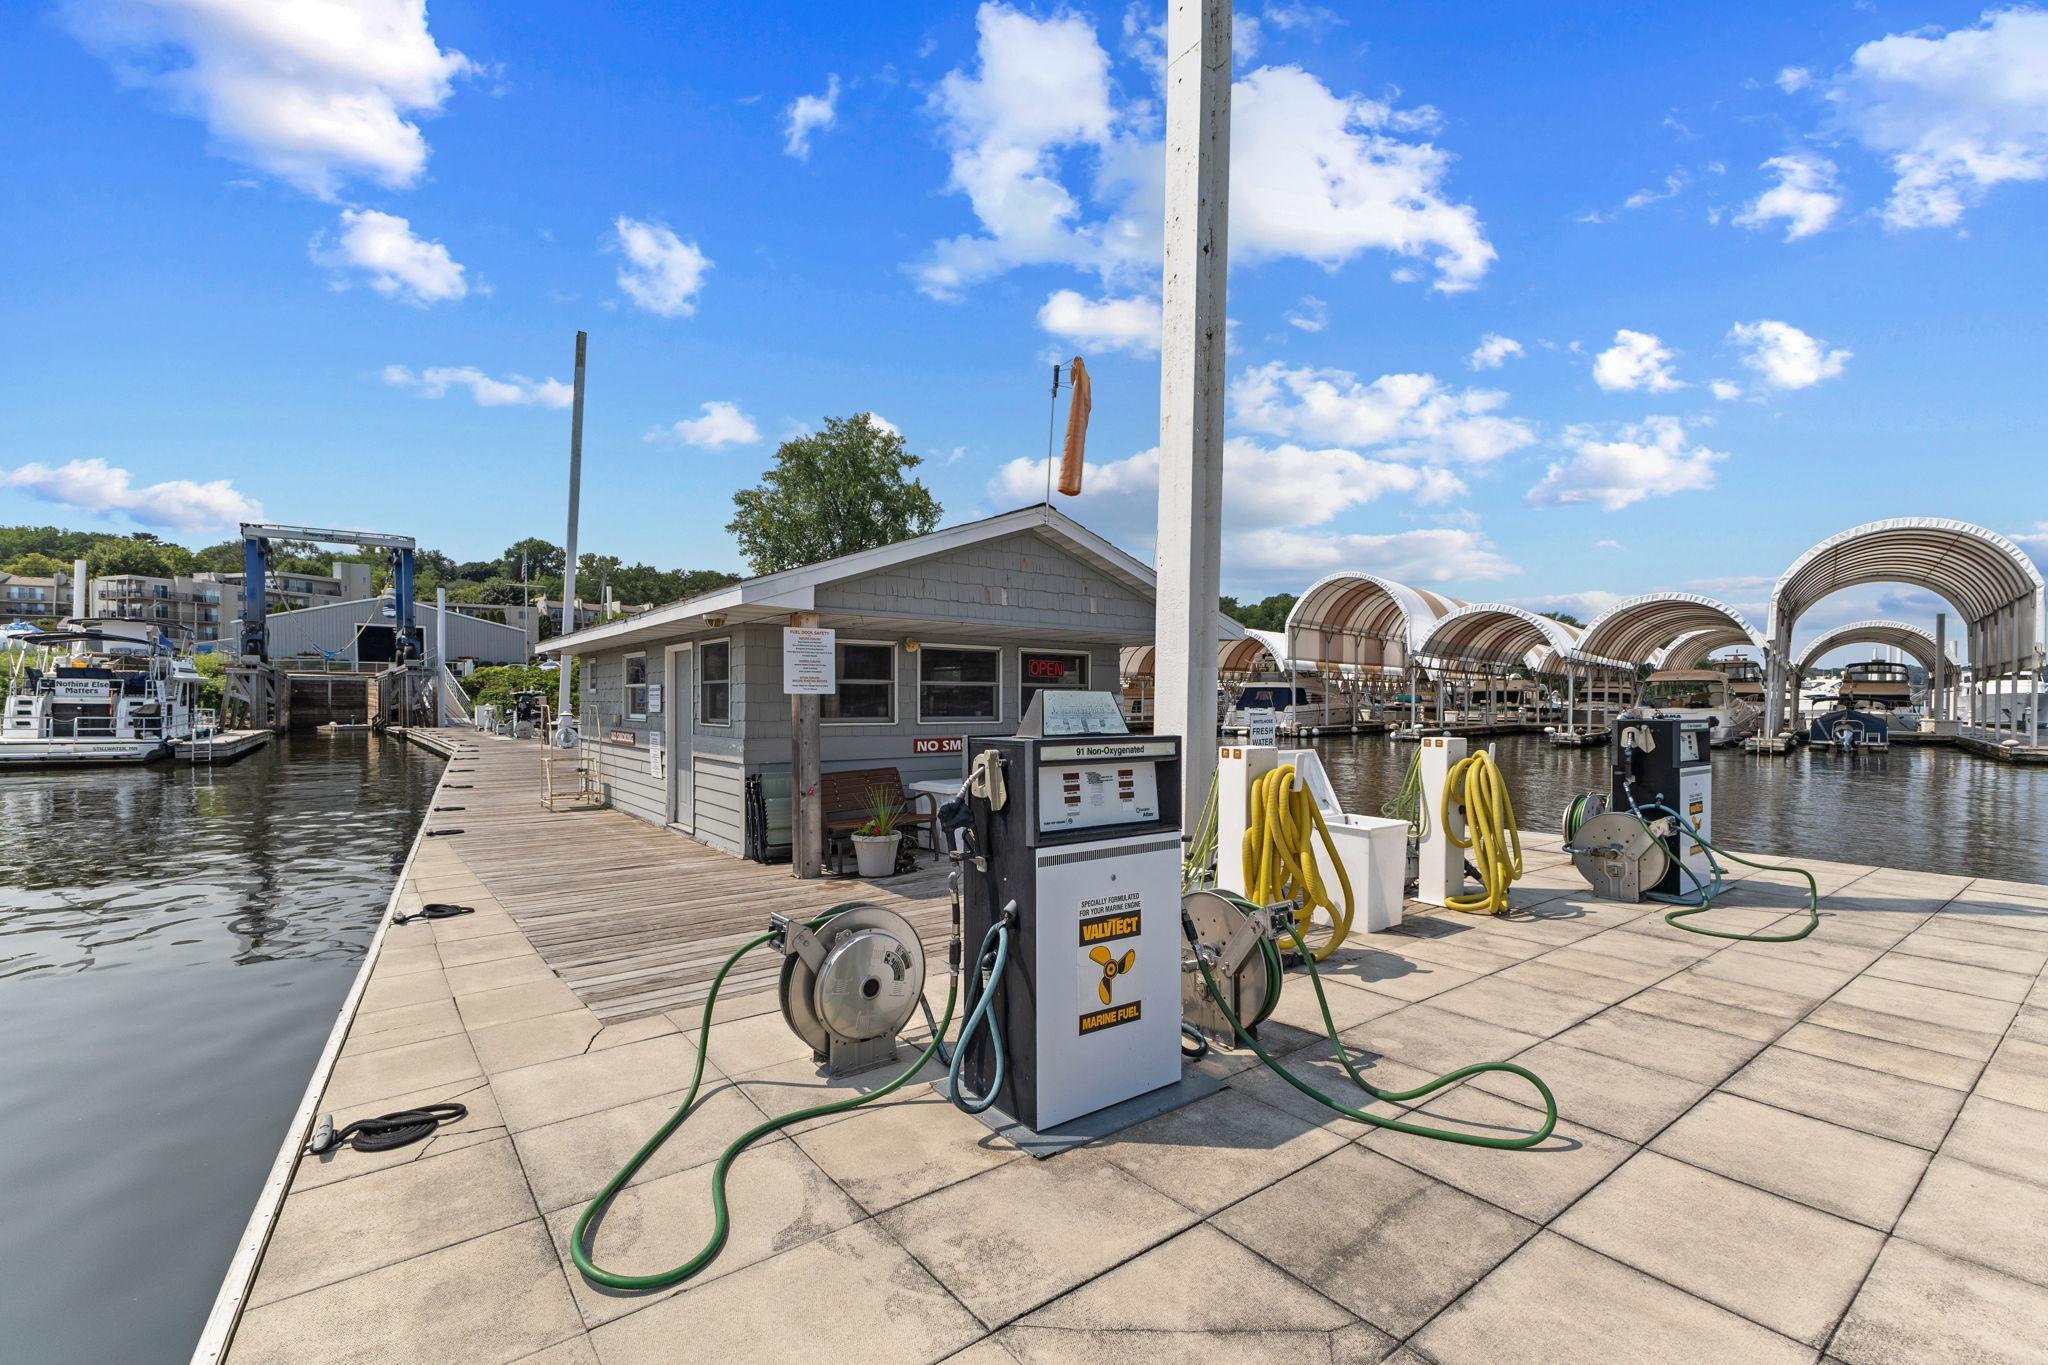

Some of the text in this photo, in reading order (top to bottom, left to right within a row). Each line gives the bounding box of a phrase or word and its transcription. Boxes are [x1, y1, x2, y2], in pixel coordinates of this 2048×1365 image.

[1030, 661, 1063, 676] OPEN
[55, 680, 89, 688] Nothing
[1252, 727, 1273, 735] FRESH
[917, 740, 963, 752] NO SM
[1252, 738, 1273, 746] WATER
[1076, 745, 1145, 756] 91 Non-Oxygenated
[1081, 892, 1140, 909] SPECIALLY FORMULATED
[1079, 901, 1141, 917] FOR YOUR MARINE ENGINE
[1082, 1005, 1139, 1031] MARINE FUEL
